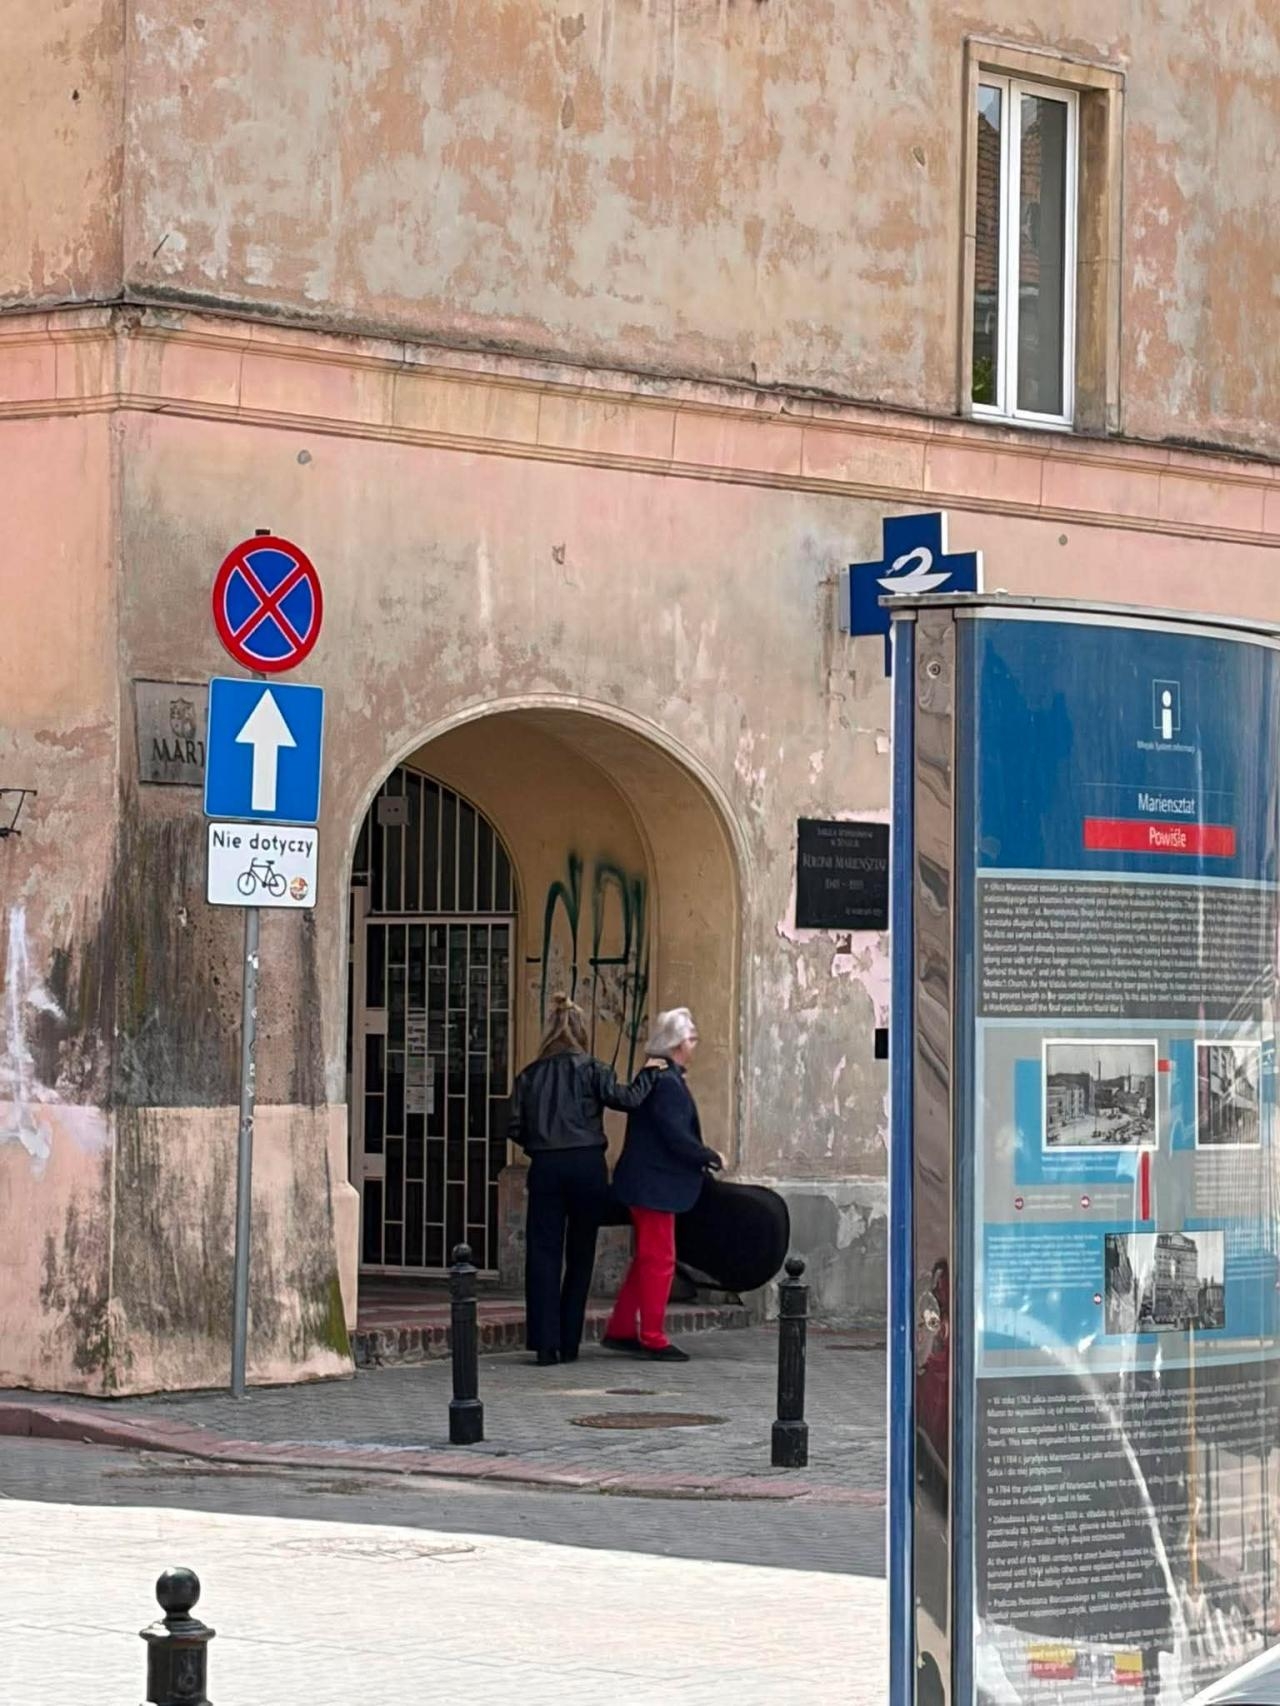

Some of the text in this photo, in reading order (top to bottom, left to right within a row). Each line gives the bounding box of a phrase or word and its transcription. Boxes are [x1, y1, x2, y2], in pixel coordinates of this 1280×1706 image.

[1138, 793, 1195, 815] Mariensztat
[213, 830, 313, 858] Nie dotyczy
[1150, 826, 1187, 848] Powiśle
